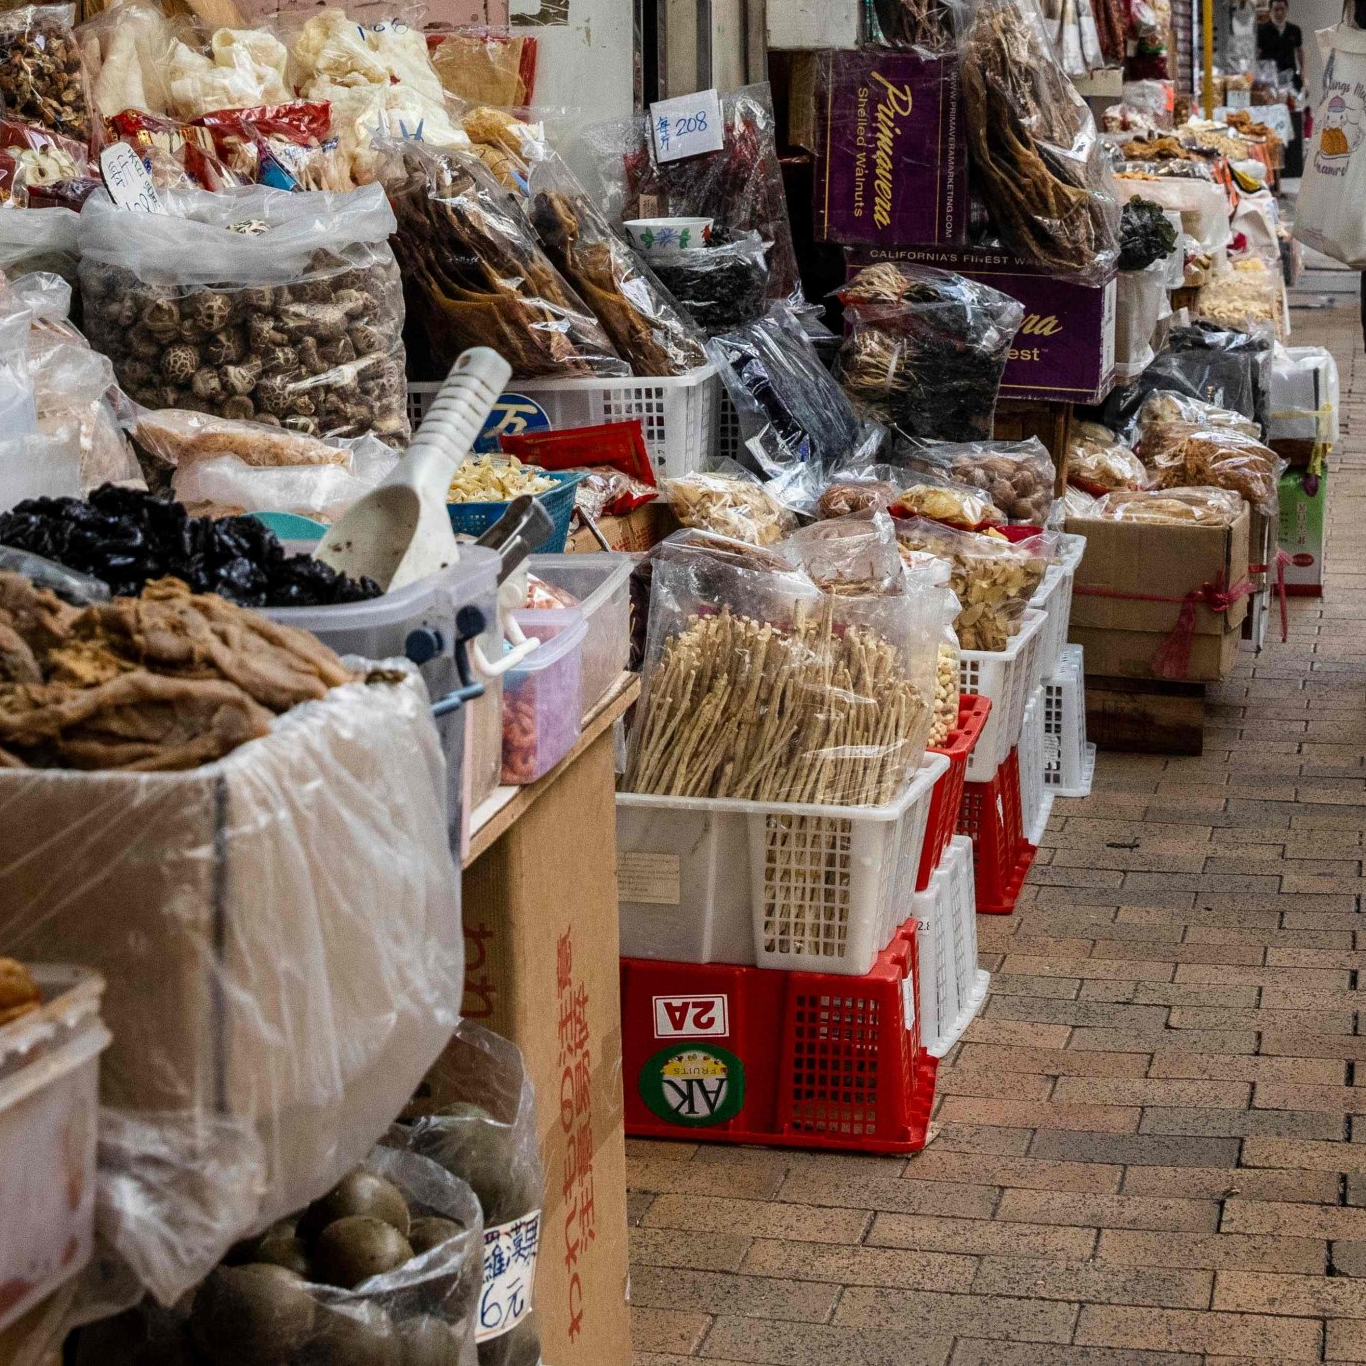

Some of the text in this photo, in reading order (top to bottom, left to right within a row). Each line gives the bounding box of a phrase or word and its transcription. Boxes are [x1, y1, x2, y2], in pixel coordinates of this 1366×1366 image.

[676, 109, 708, 136] 208
[854, 87, 869, 217] Shelled Walnuts
[870, 70, 913, 230] Primavera
[870, 249, 958, 263] CALIFORNIA'S
[963, 256, 1008, 265] FINEST
[663, 1000, 715, 1031] 2A
[662, 1077, 728, 1114] AK
